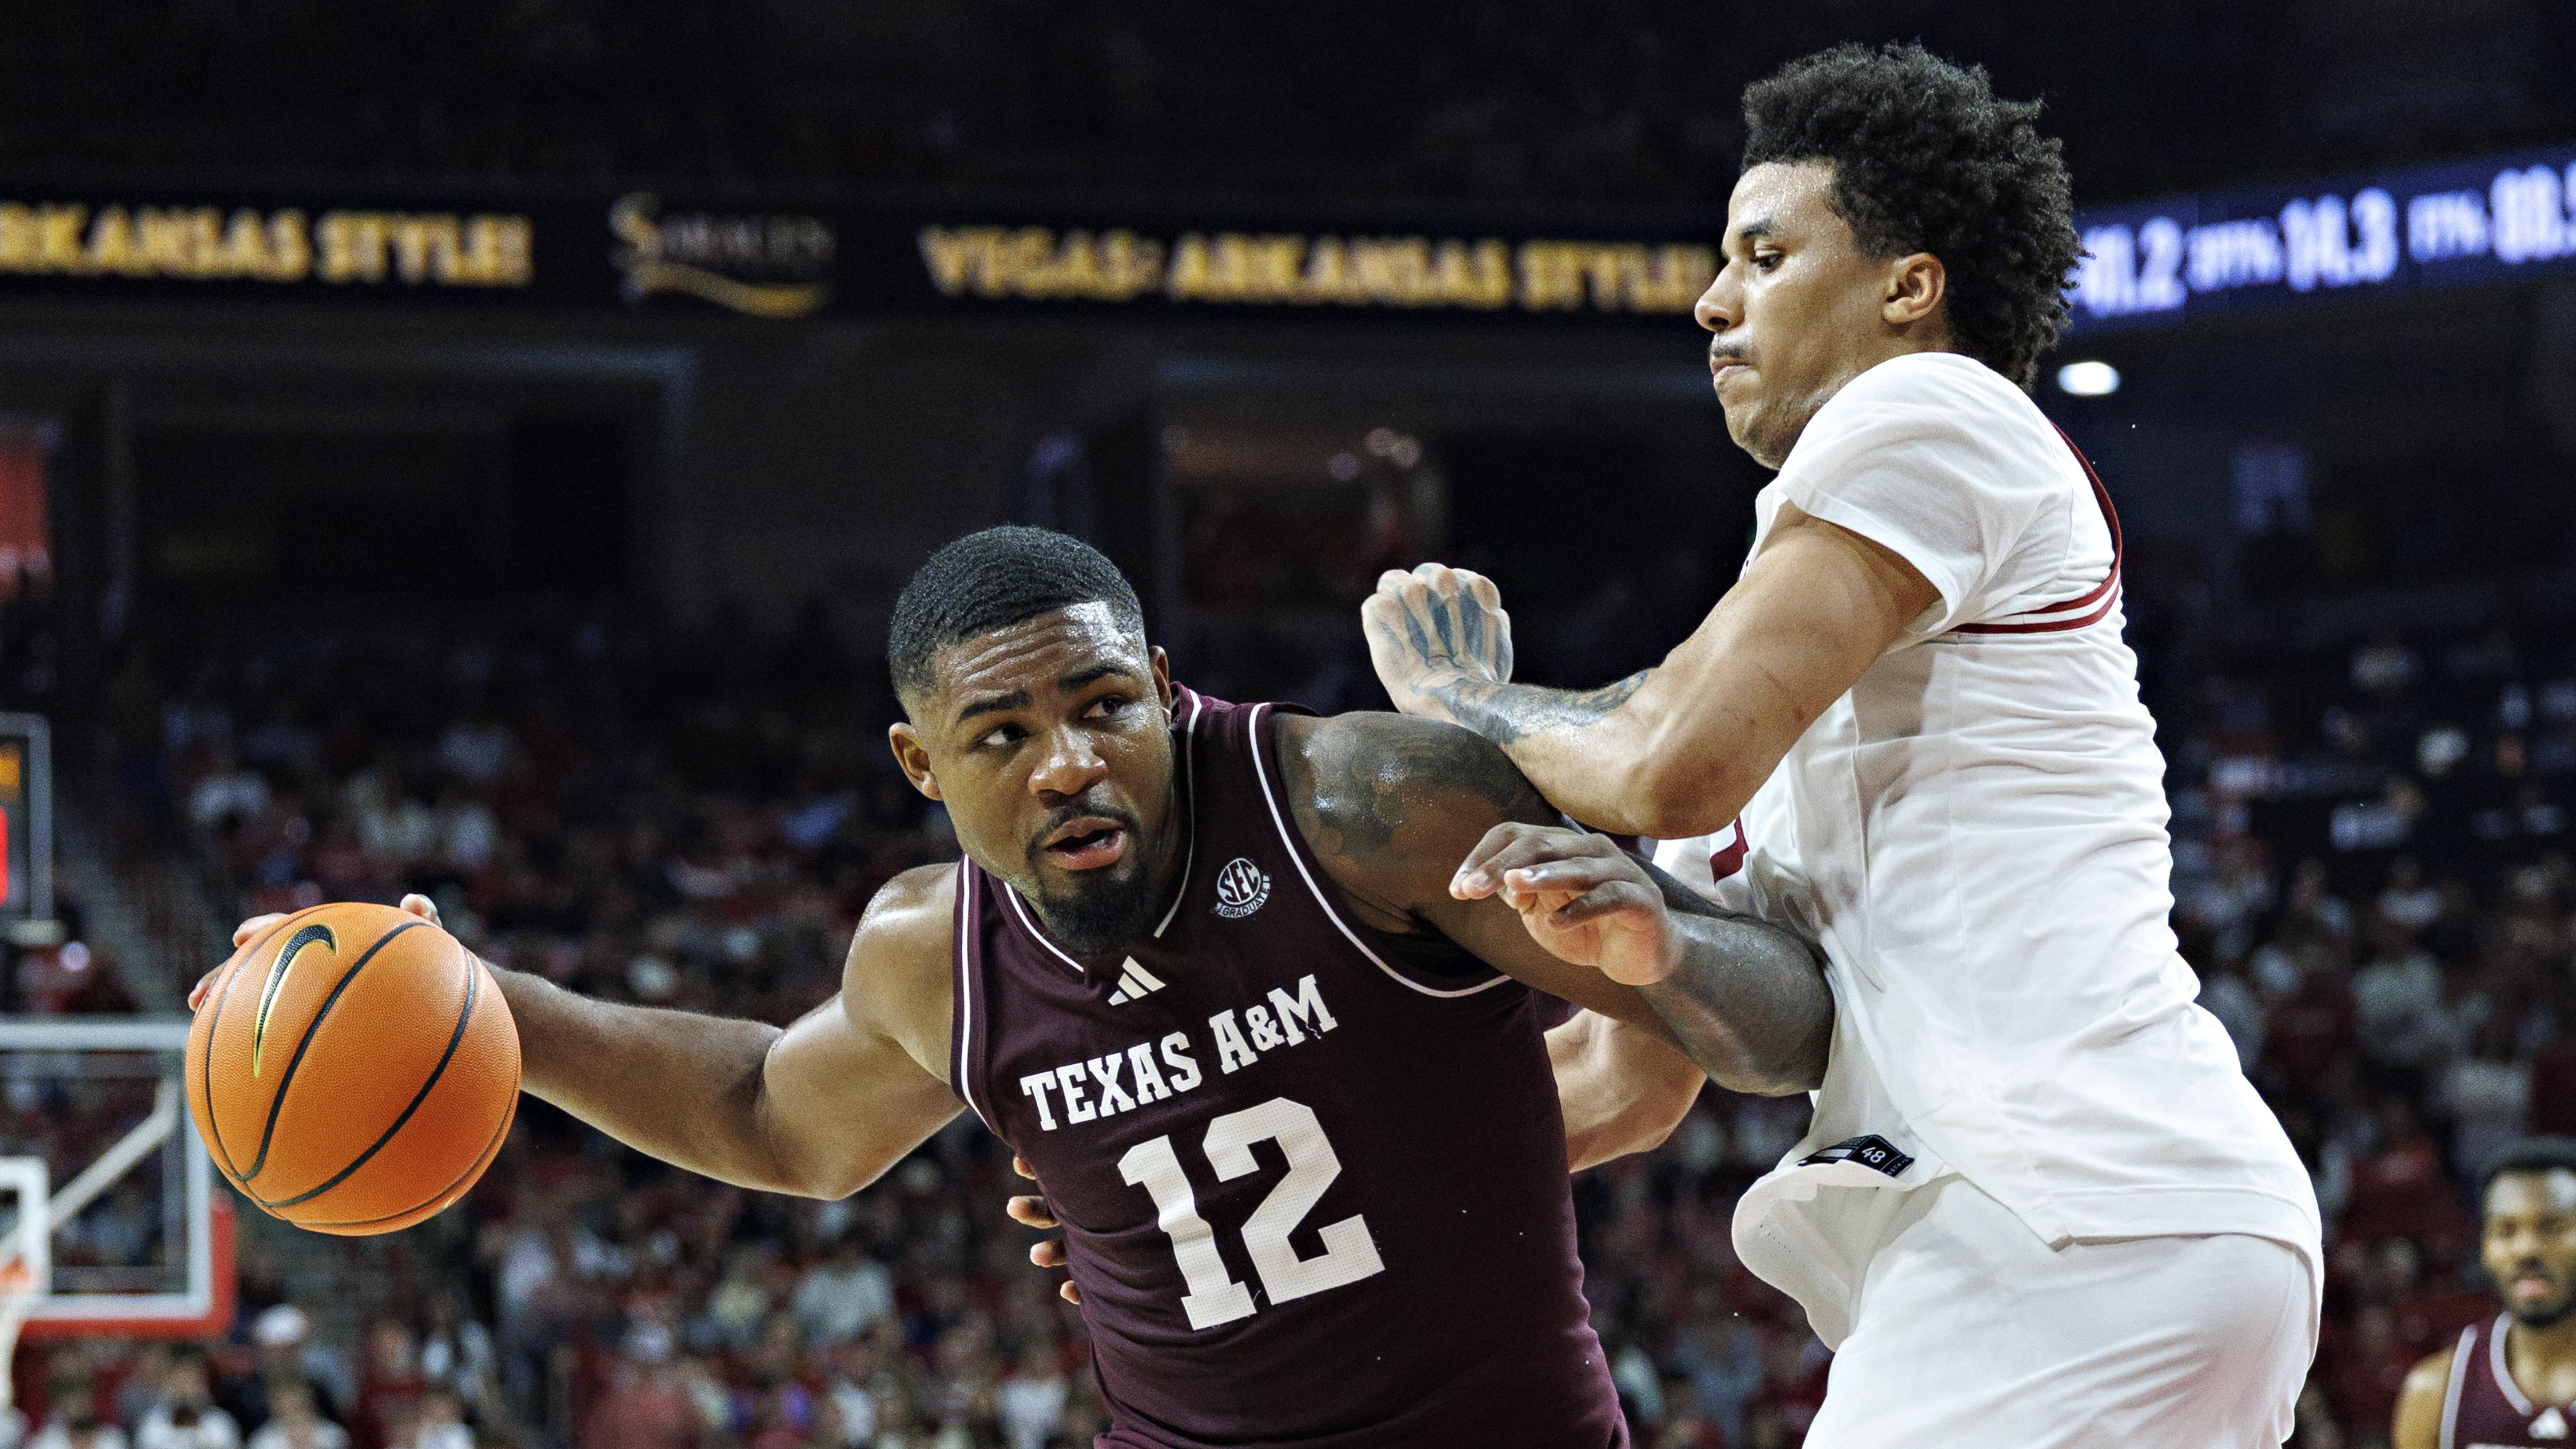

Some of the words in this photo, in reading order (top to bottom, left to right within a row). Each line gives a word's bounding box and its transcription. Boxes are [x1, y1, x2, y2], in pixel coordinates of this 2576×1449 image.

[316, 210, 533, 287] STYLE!
[1167, 233, 1510, 310] ARKANSAS
[1219, 859, 1260, 903] SEC
[1221, 887, 1270, 917] GRADUATE
[1020, 1031, 1201, 1130] TEXAS
[1209, 974, 1338, 1074] A&M
[1861, 1147, 1886, 1164] 48
[1117, 1097, 1385, 1331] 12
